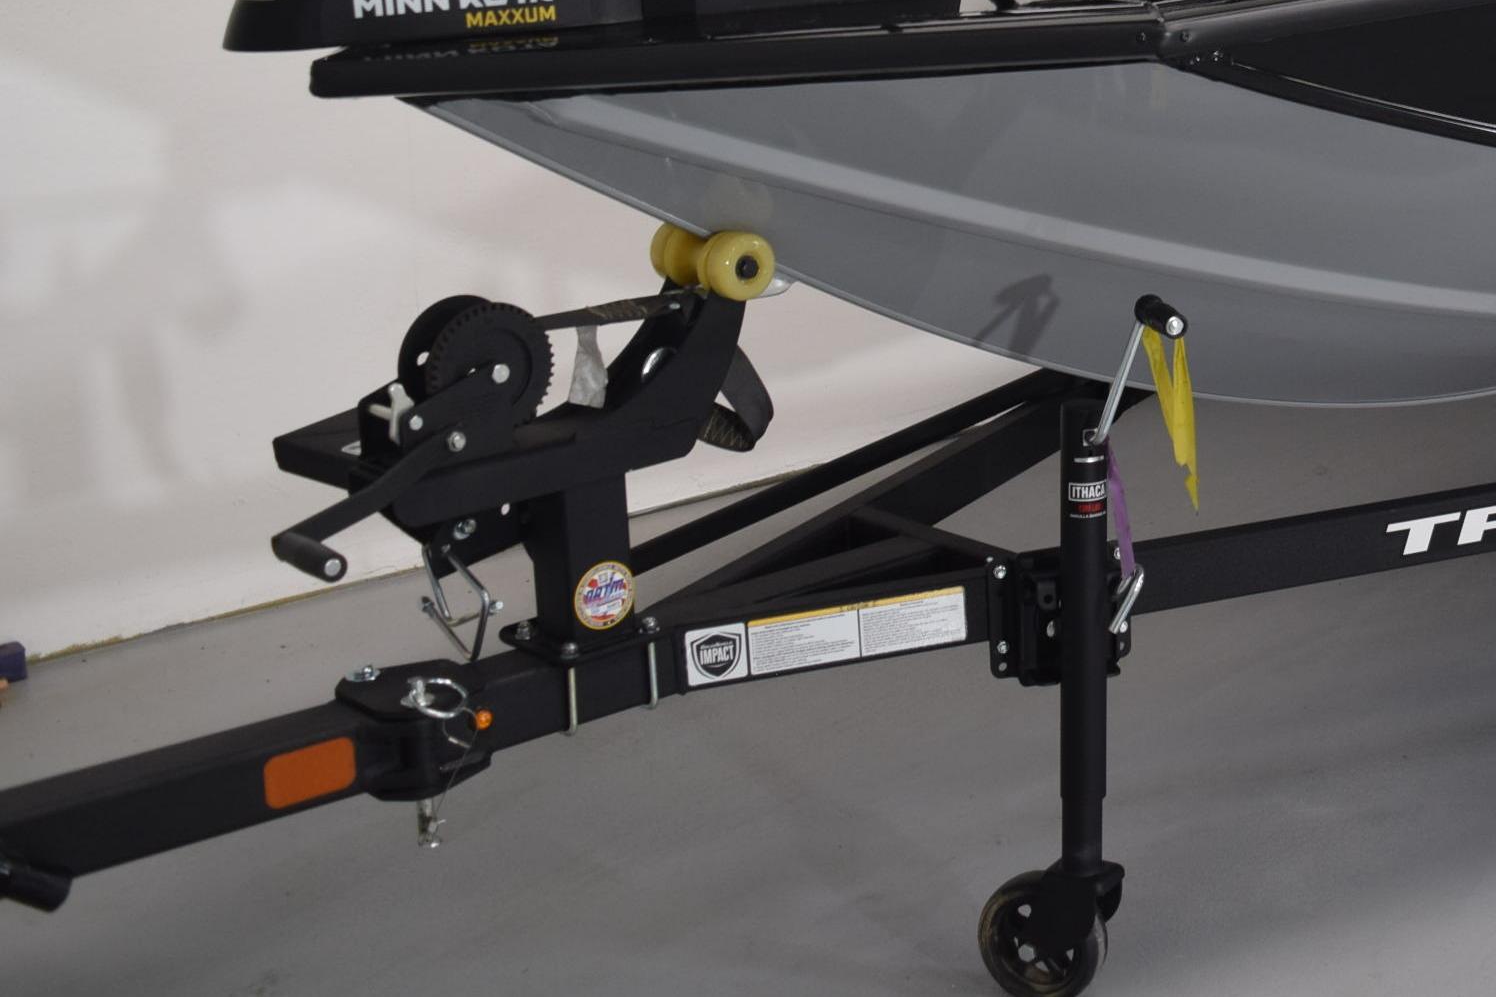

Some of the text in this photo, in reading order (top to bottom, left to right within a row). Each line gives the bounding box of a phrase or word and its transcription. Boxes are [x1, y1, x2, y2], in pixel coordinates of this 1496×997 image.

[465, 5, 556, 28] MAXXUM
[1072, 483, 1105, 499] ITHACA
[700, 645, 734, 665] IMPACT
